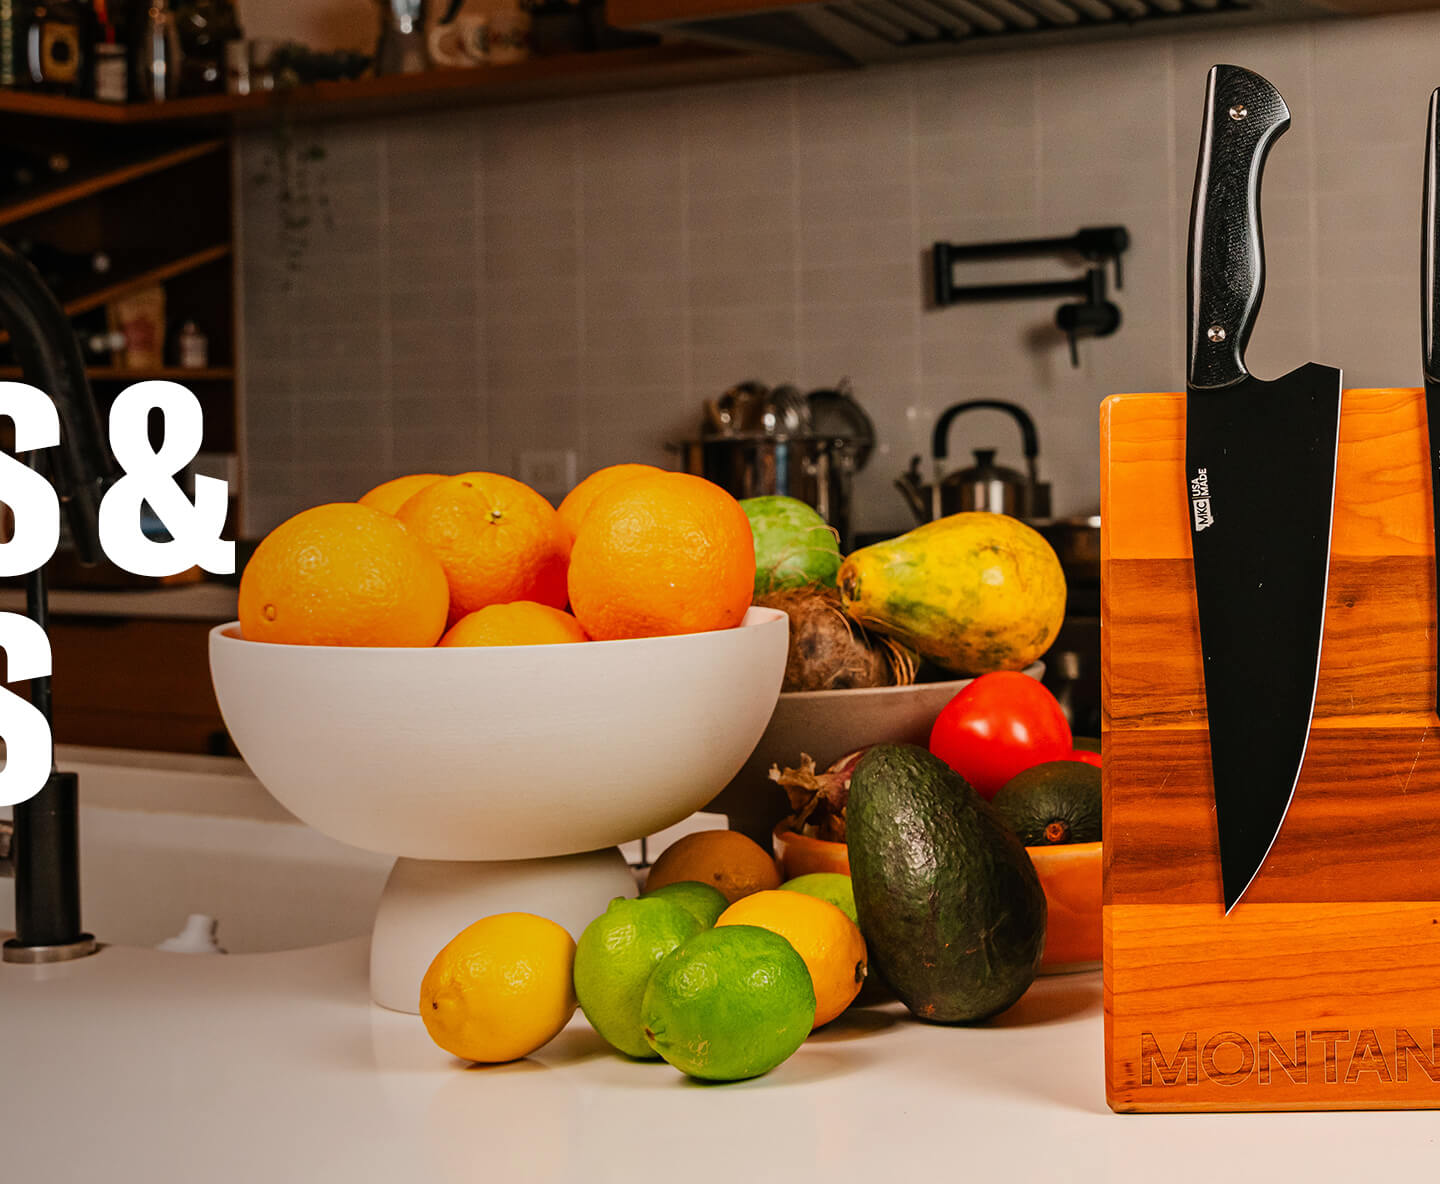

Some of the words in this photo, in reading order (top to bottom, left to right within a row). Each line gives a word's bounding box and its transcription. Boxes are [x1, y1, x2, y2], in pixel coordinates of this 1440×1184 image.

[1191, 478, 1201, 497] USA
[1198, 468, 1209, 496] MADE
[1196, 501, 1209, 525] MKC
